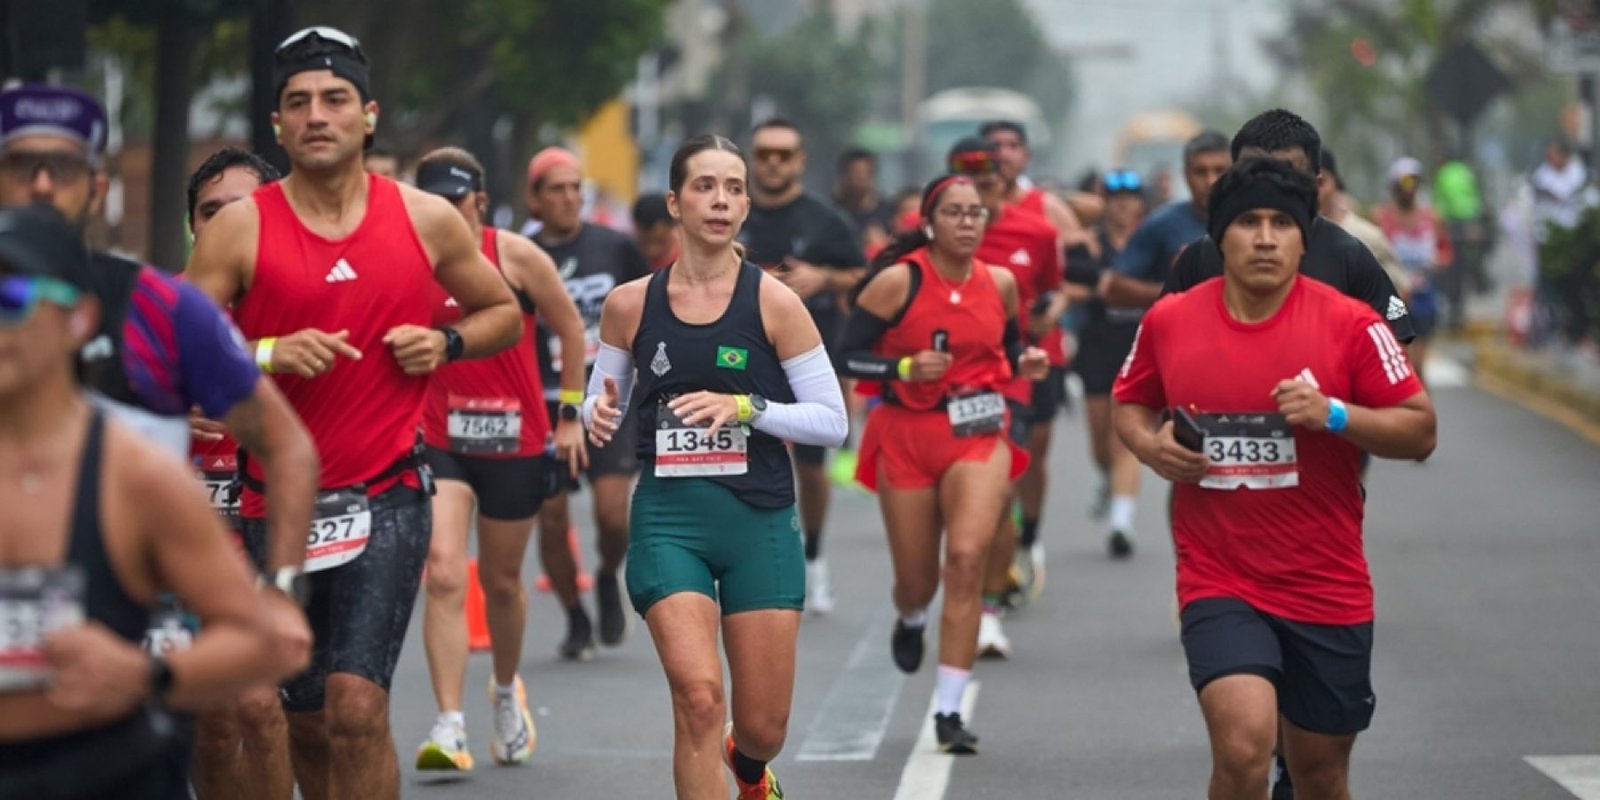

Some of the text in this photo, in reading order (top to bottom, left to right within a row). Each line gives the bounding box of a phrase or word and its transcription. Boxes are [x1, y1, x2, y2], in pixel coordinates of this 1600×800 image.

[461, 419, 508, 435] 7562
[666, 430, 733, 452] 1345
[1209, 440, 1280, 462] 3433
